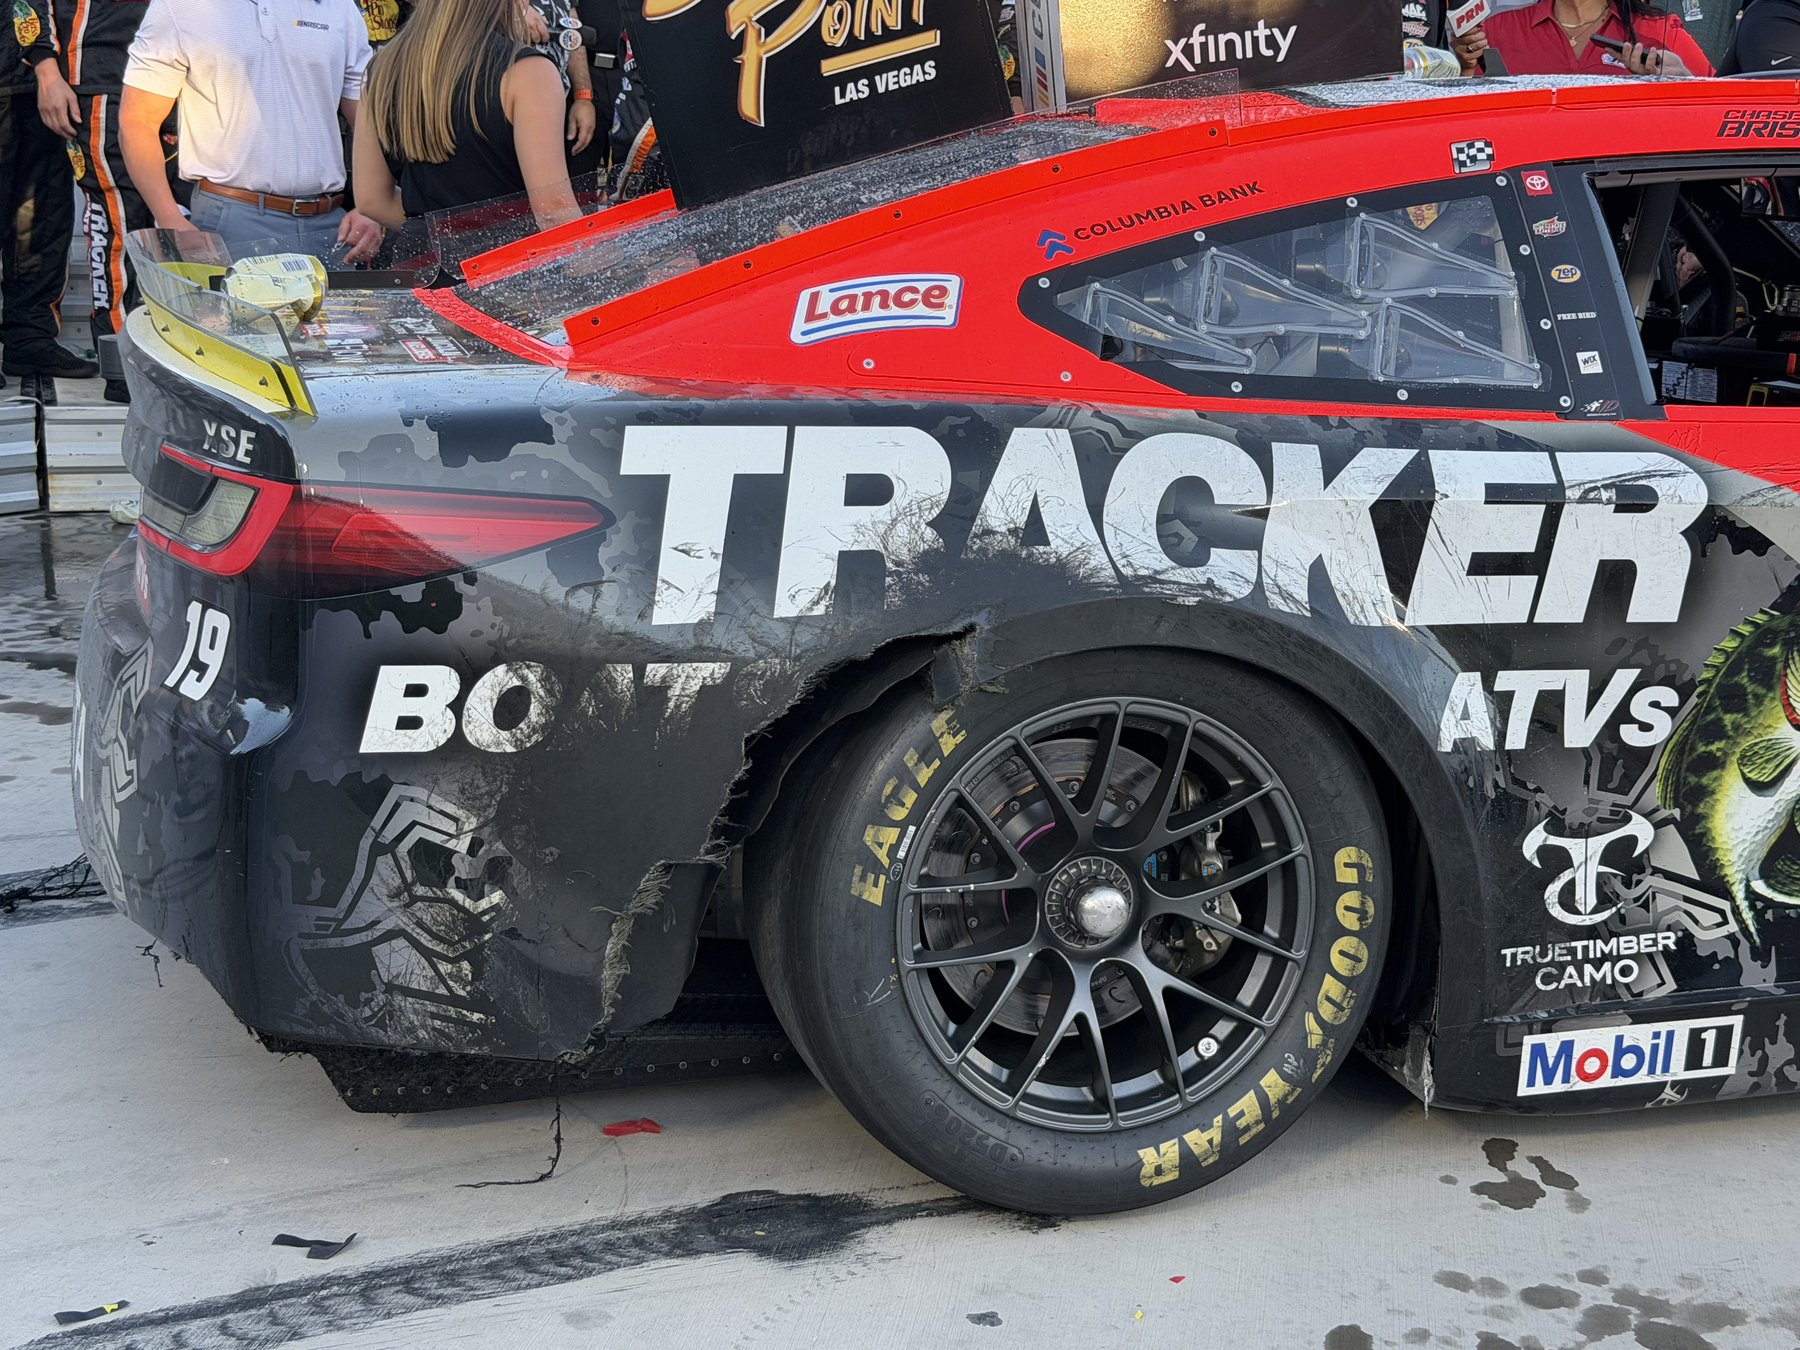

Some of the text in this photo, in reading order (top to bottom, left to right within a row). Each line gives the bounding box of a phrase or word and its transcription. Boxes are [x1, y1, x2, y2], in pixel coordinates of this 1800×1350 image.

[303, 20, 329, 31] NASCAR
[1456, 1, 1485, 30] PRN
[1164, 19, 1297, 72] xfinity
[834, 61, 937, 106] LAS VEGAS
[1074, 181, 1265, 240] COLUMBIA BANK
[803, 284, 950, 325] Lance
[1581, 354, 1597, 366] WIX
[202, 418, 257, 464] XSE
[619, 425, 1708, 627] TRACKER
[164, 600, 231, 701] 19
[1437, 668, 1679, 752] ATVs
[850, 708, 967, 907] EAGLE
[1501, 931, 1678, 968] TRUETIMBER
[1535, 959, 1639, 991] CAMO
[1526, 1028, 1717, 1088] Mobil 1
